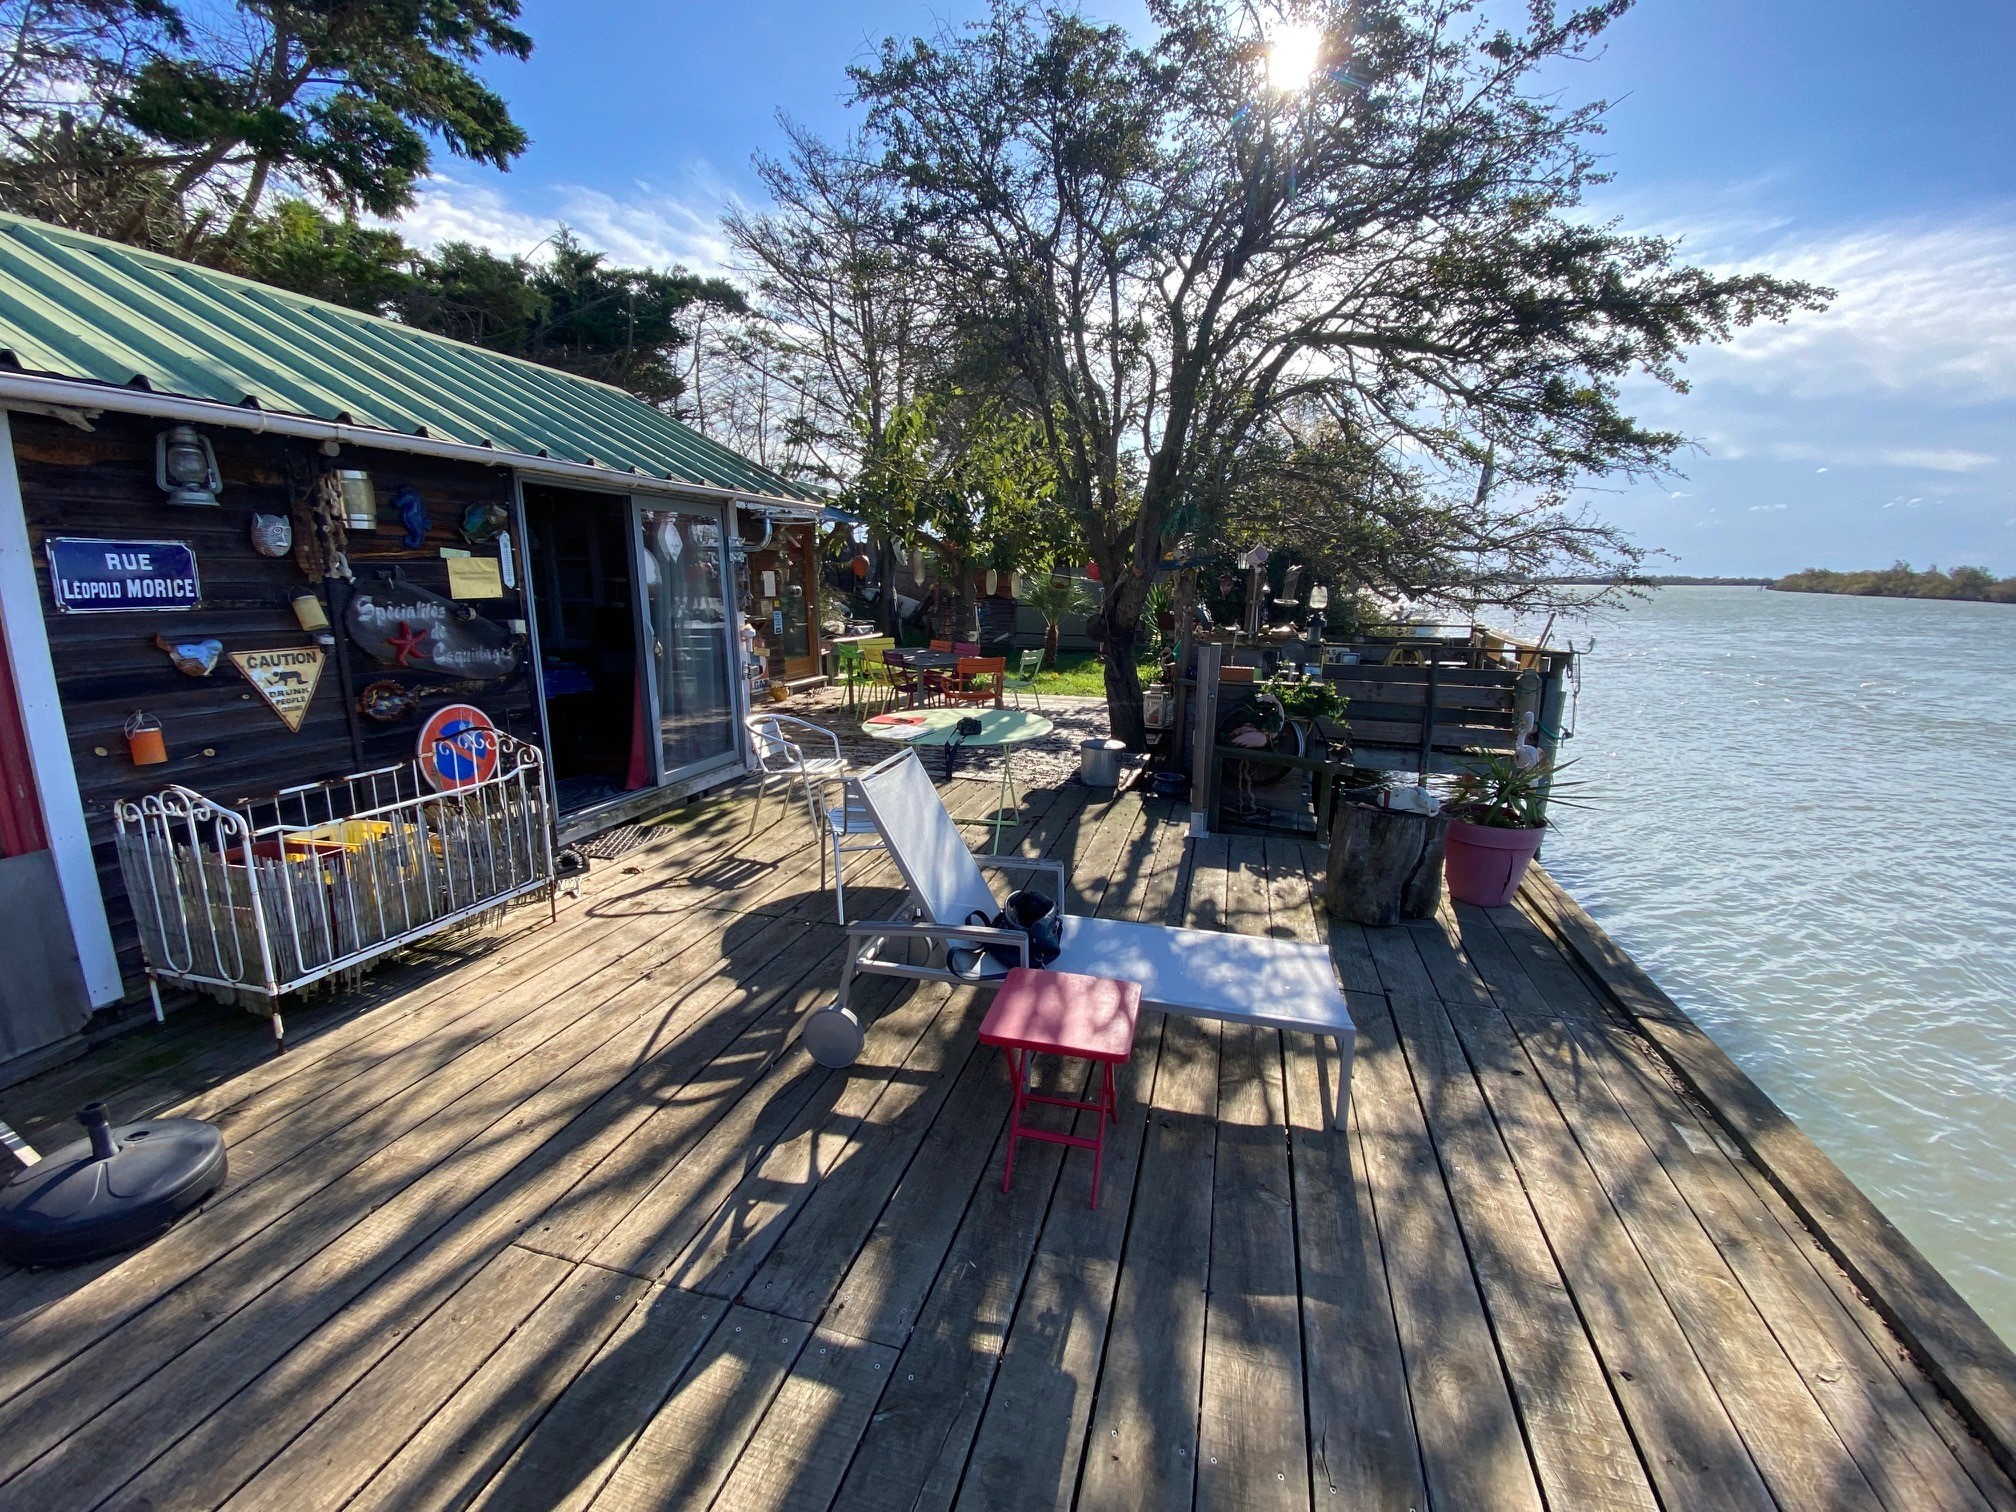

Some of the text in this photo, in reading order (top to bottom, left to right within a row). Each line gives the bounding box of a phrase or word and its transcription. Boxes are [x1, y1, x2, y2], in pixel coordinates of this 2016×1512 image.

[105, 553, 153, 570] RUE
[62, 578, 195, 599] LÉOPOLD MORICE
[246, 651, 317, 668] CAUTION
[268, 688, 310, 697] DRUNK
[275, 696, 306, 705] PEOPLE
